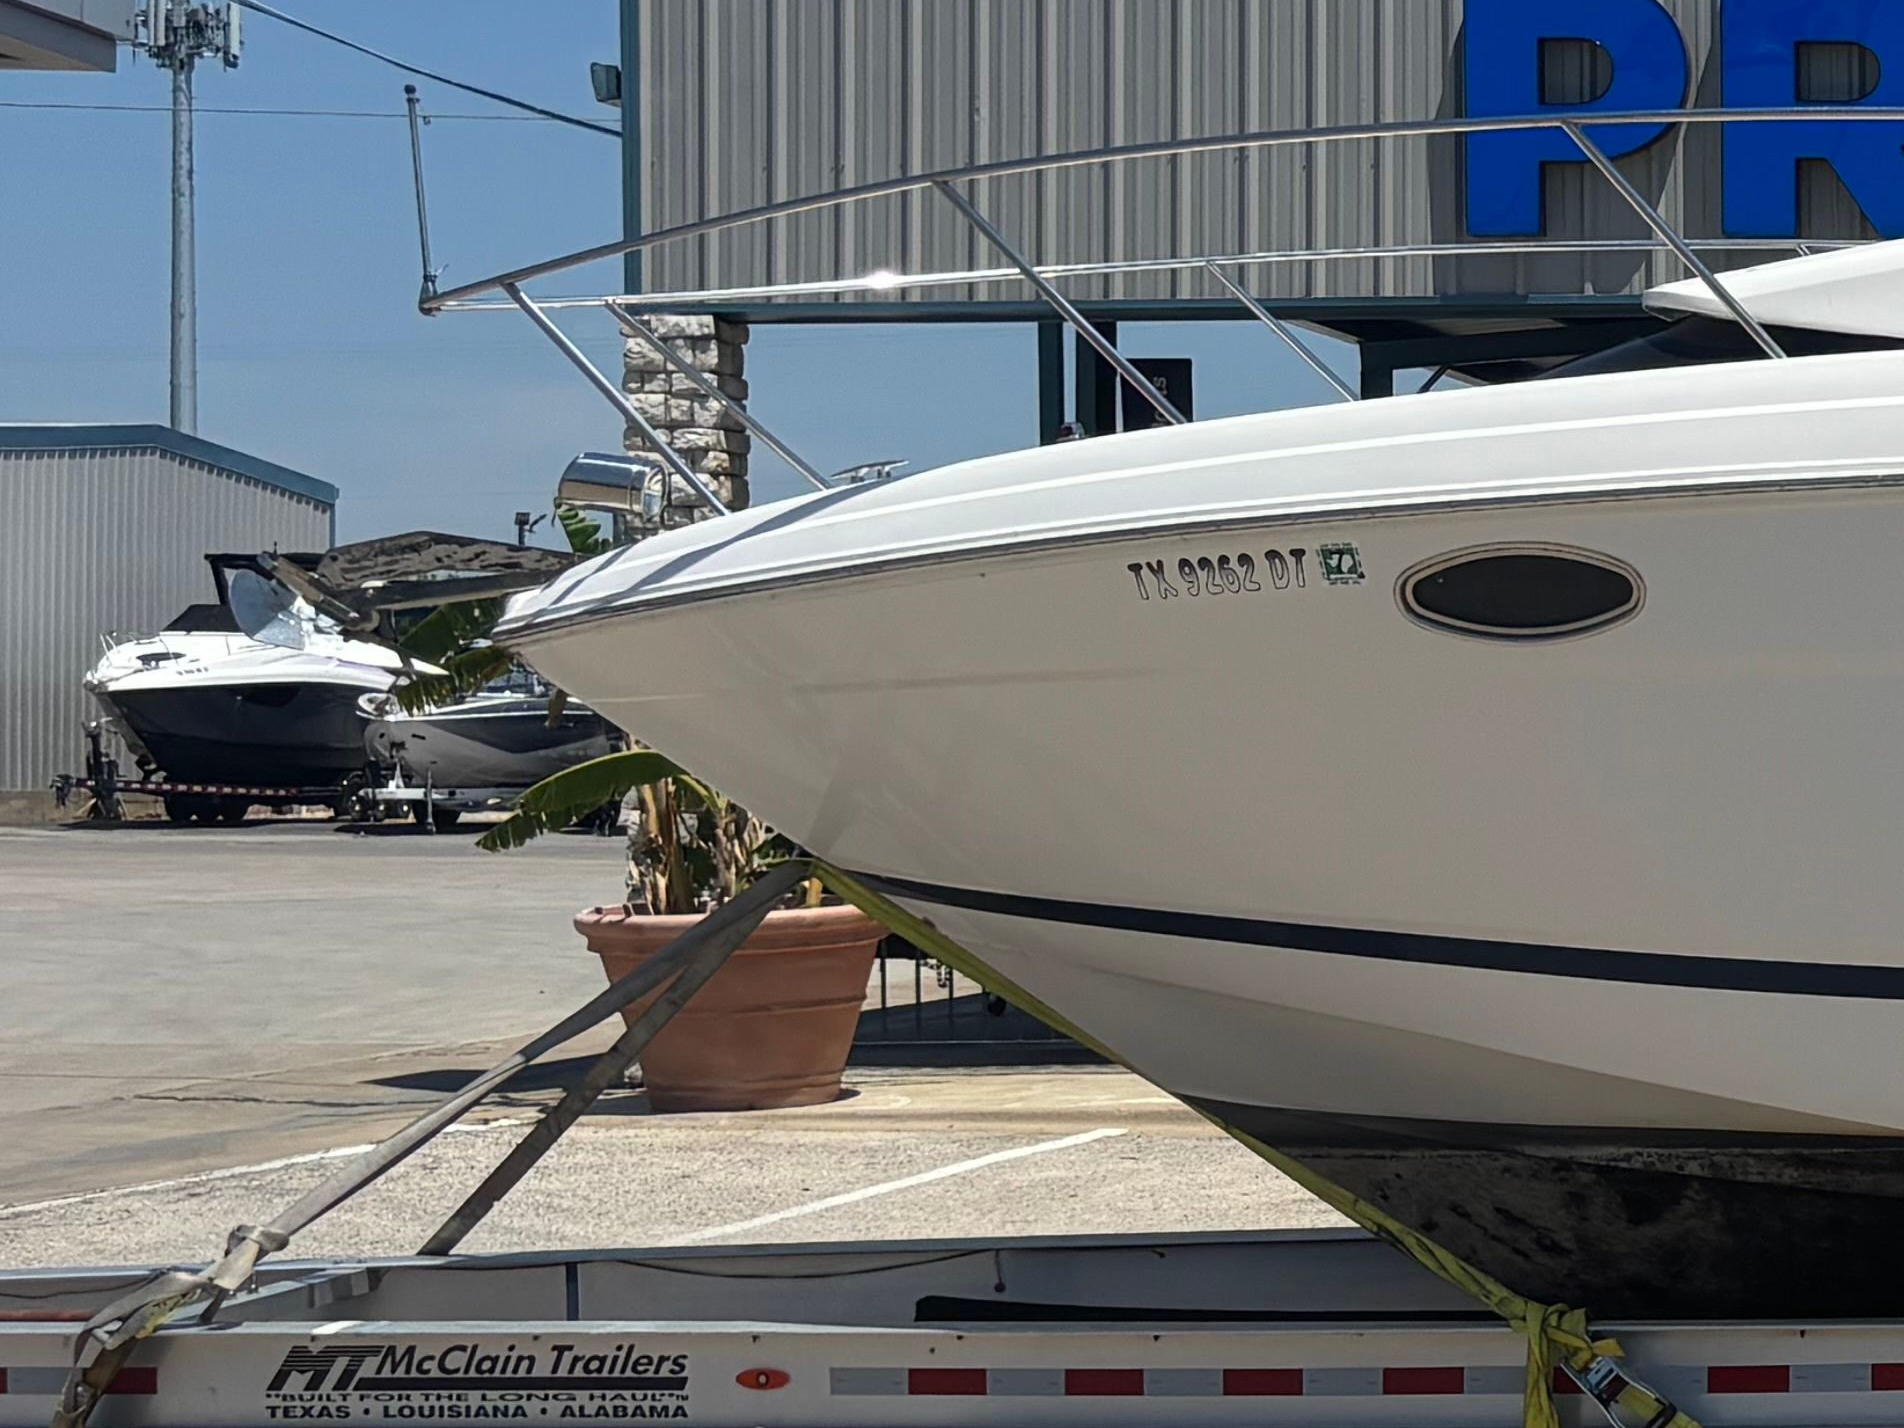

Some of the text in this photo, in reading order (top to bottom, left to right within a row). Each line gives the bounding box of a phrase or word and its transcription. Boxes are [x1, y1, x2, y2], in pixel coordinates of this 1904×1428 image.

[1127, 547, 1307, 601] TX 9262 DT
[374, 1343, 537, 1376] McClain
[550, 1343, 689, 1376] Trailers
[359, 1393, 413, 1403] FOR
[420, 1393, 469, 1403] THE
[481, 1393, 577, 1403] LONG
[265, 1404, 689, 1419] TEXAS LOUISIANA ALABAMA
